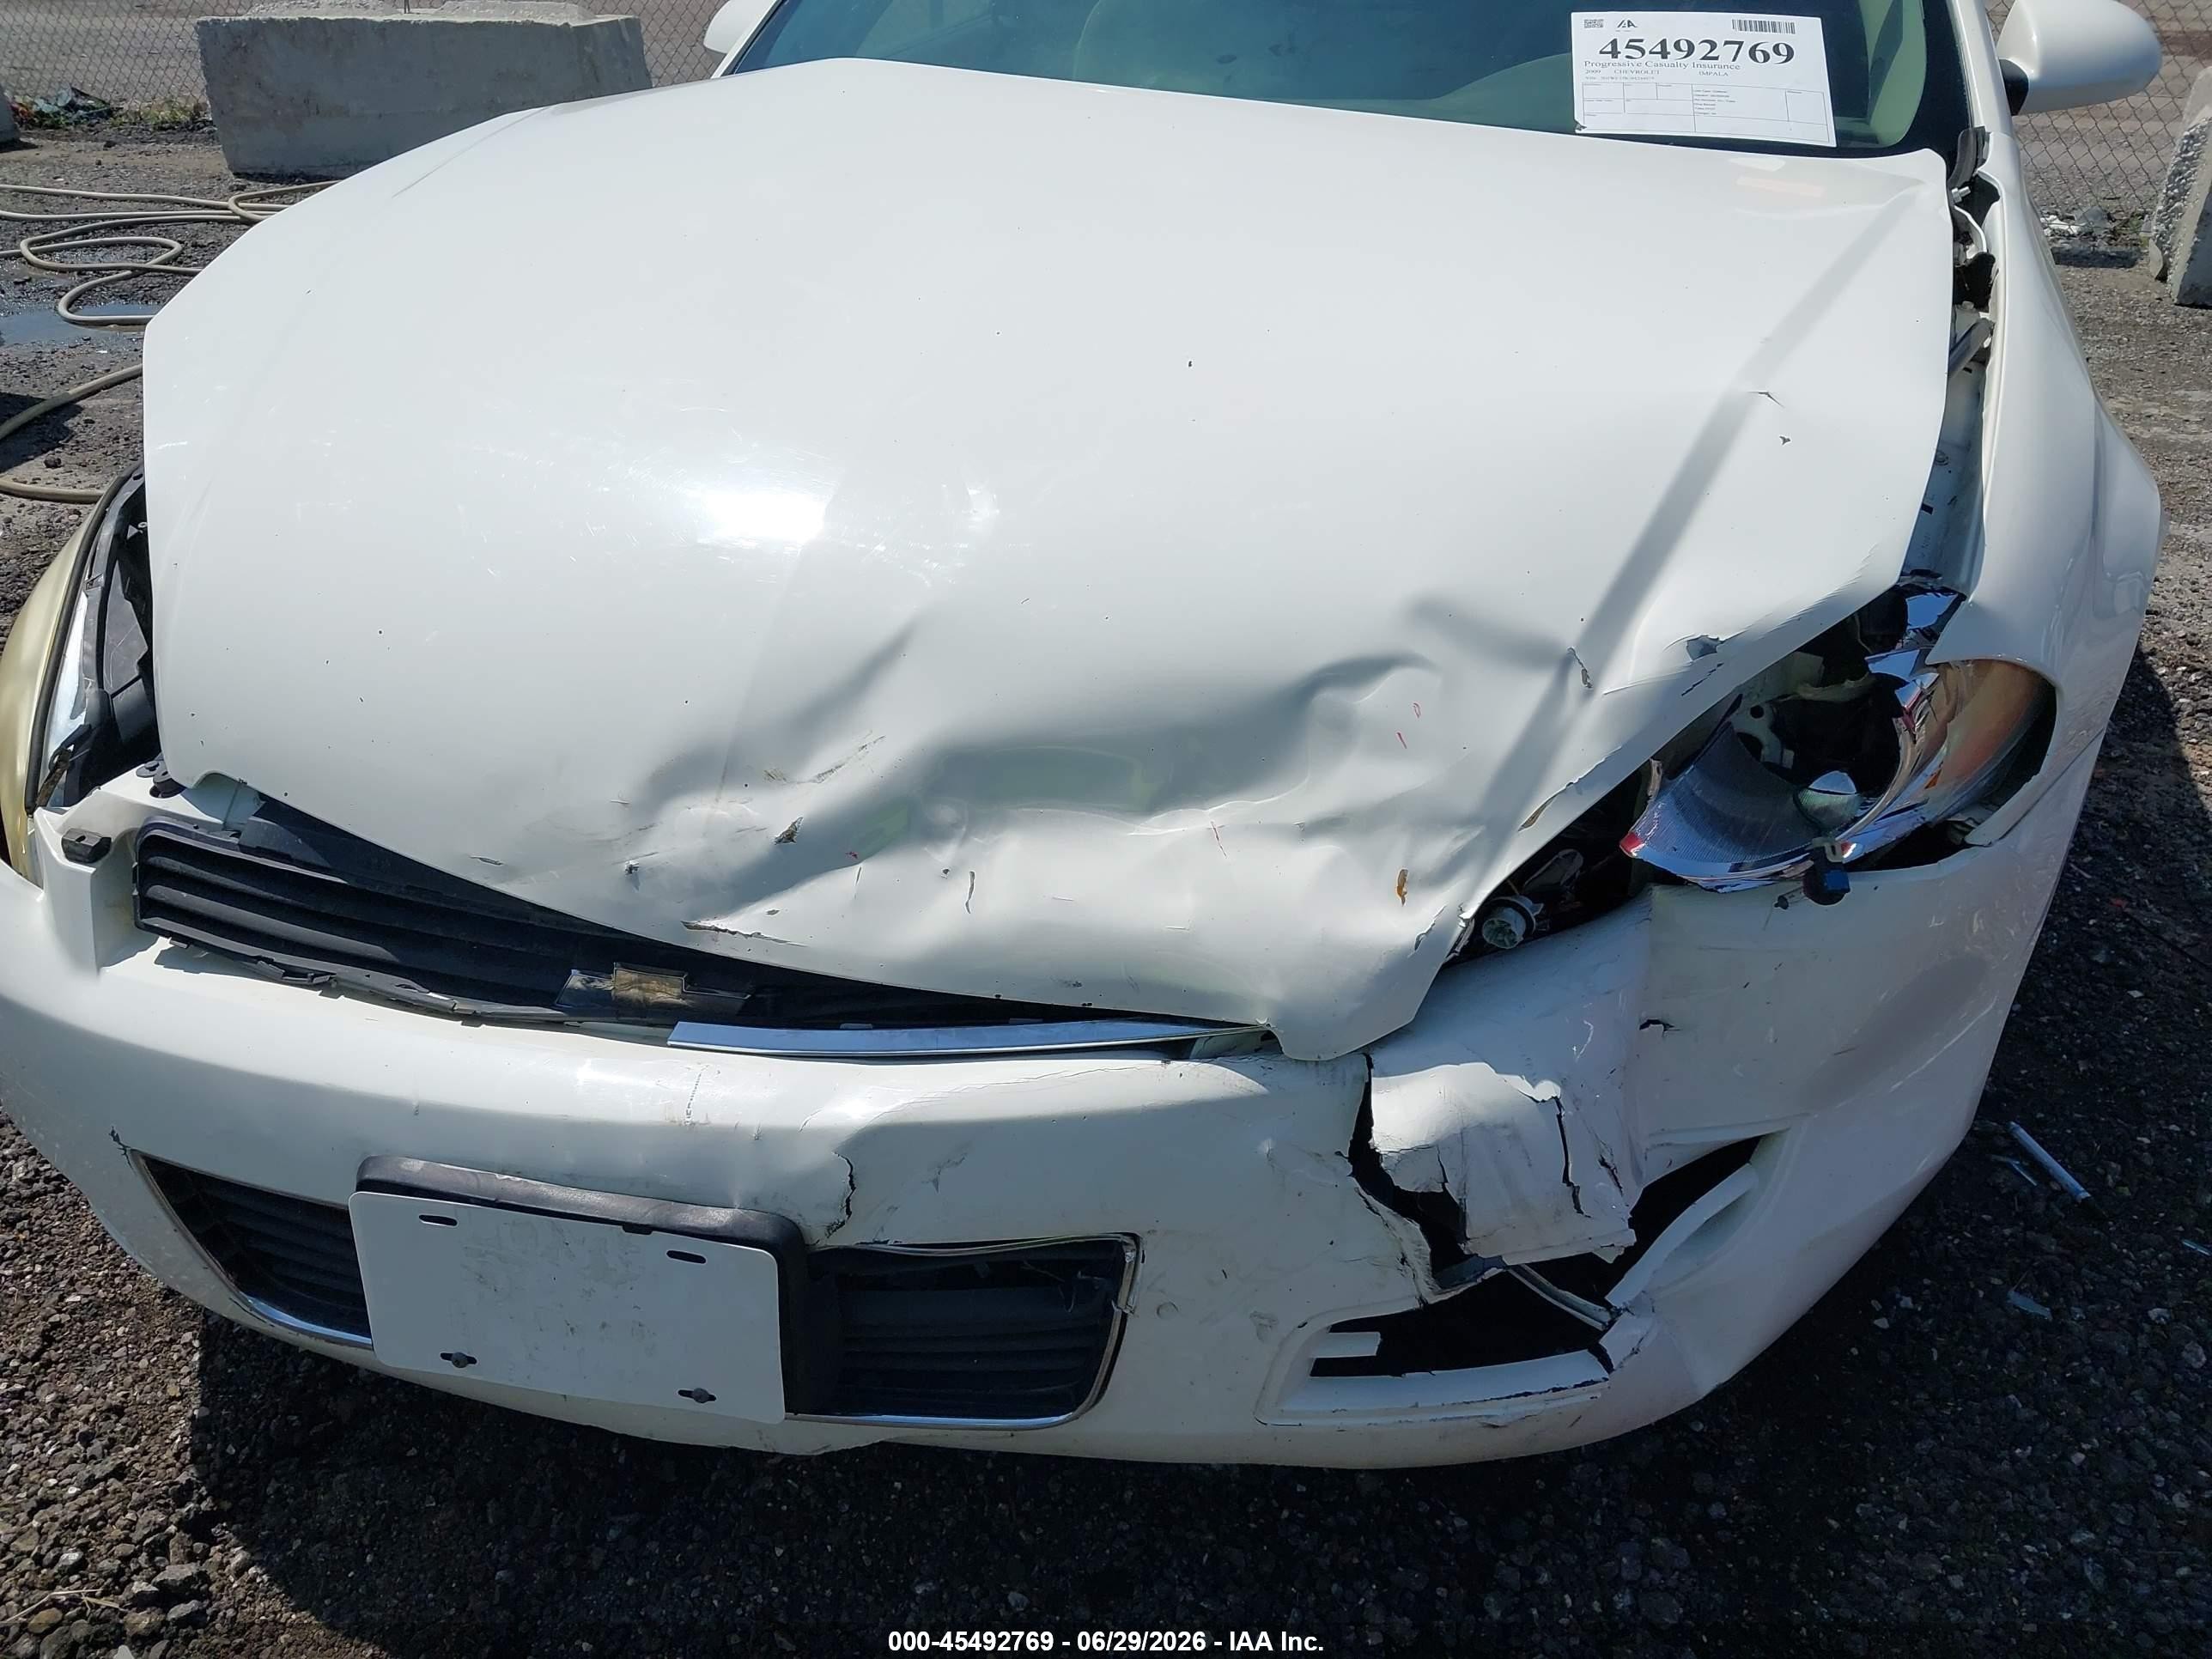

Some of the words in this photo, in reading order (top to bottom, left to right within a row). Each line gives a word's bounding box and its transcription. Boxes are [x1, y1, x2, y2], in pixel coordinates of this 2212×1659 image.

[1599, 38, 1795, 64] 45492769
[1584, 60, 1642, 70] Progressive
[1645, 61, 1689, 70] Casualty
[1692, 62, 1741, 70] Insurance
